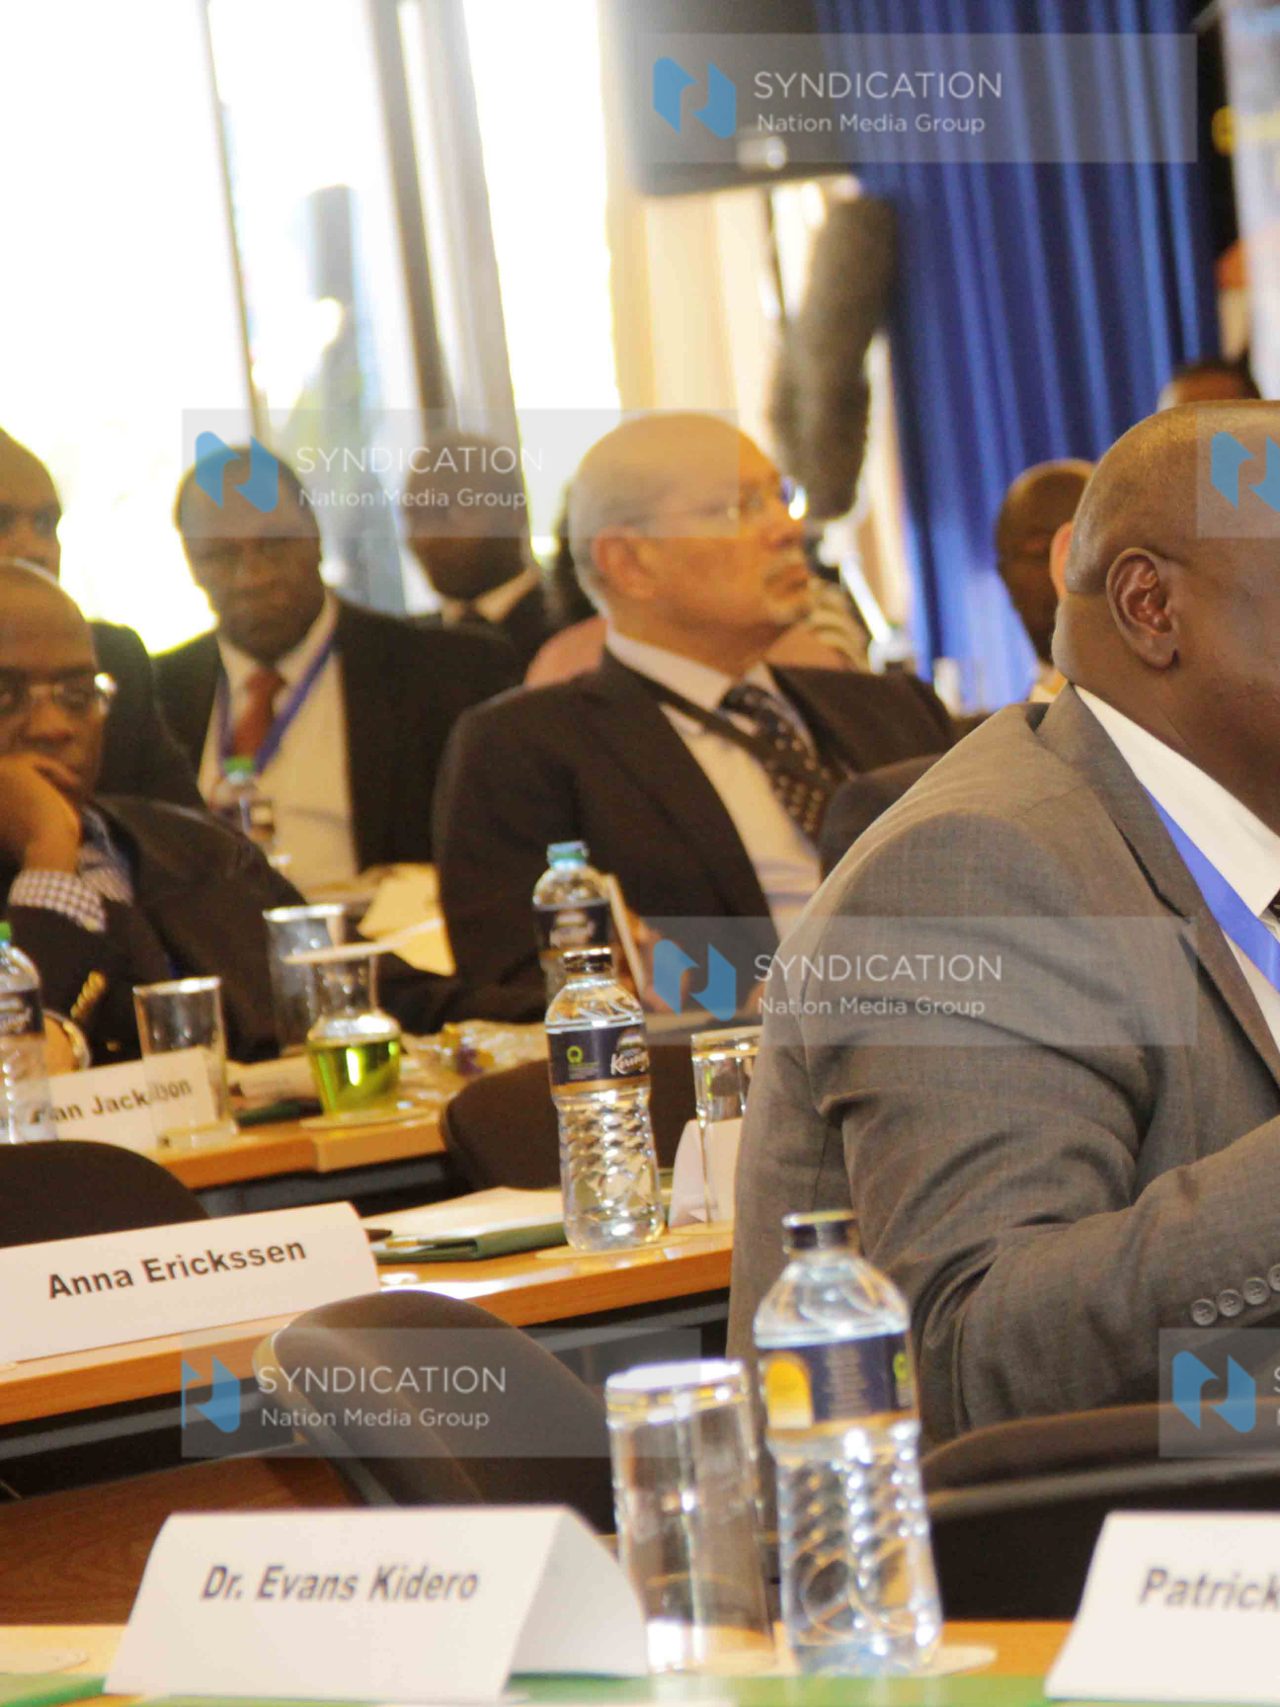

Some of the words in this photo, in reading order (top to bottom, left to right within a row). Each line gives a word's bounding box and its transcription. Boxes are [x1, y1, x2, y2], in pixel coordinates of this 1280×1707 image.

[49, 1266, 134, 1299] Anna
[141, 1241, 307, 1284] Erickssen
[202, 1564, 243, 1600] Dr.
[256, 1564, 359, 1600] Evans
[368, 1564, 480, 1600] Kidero
